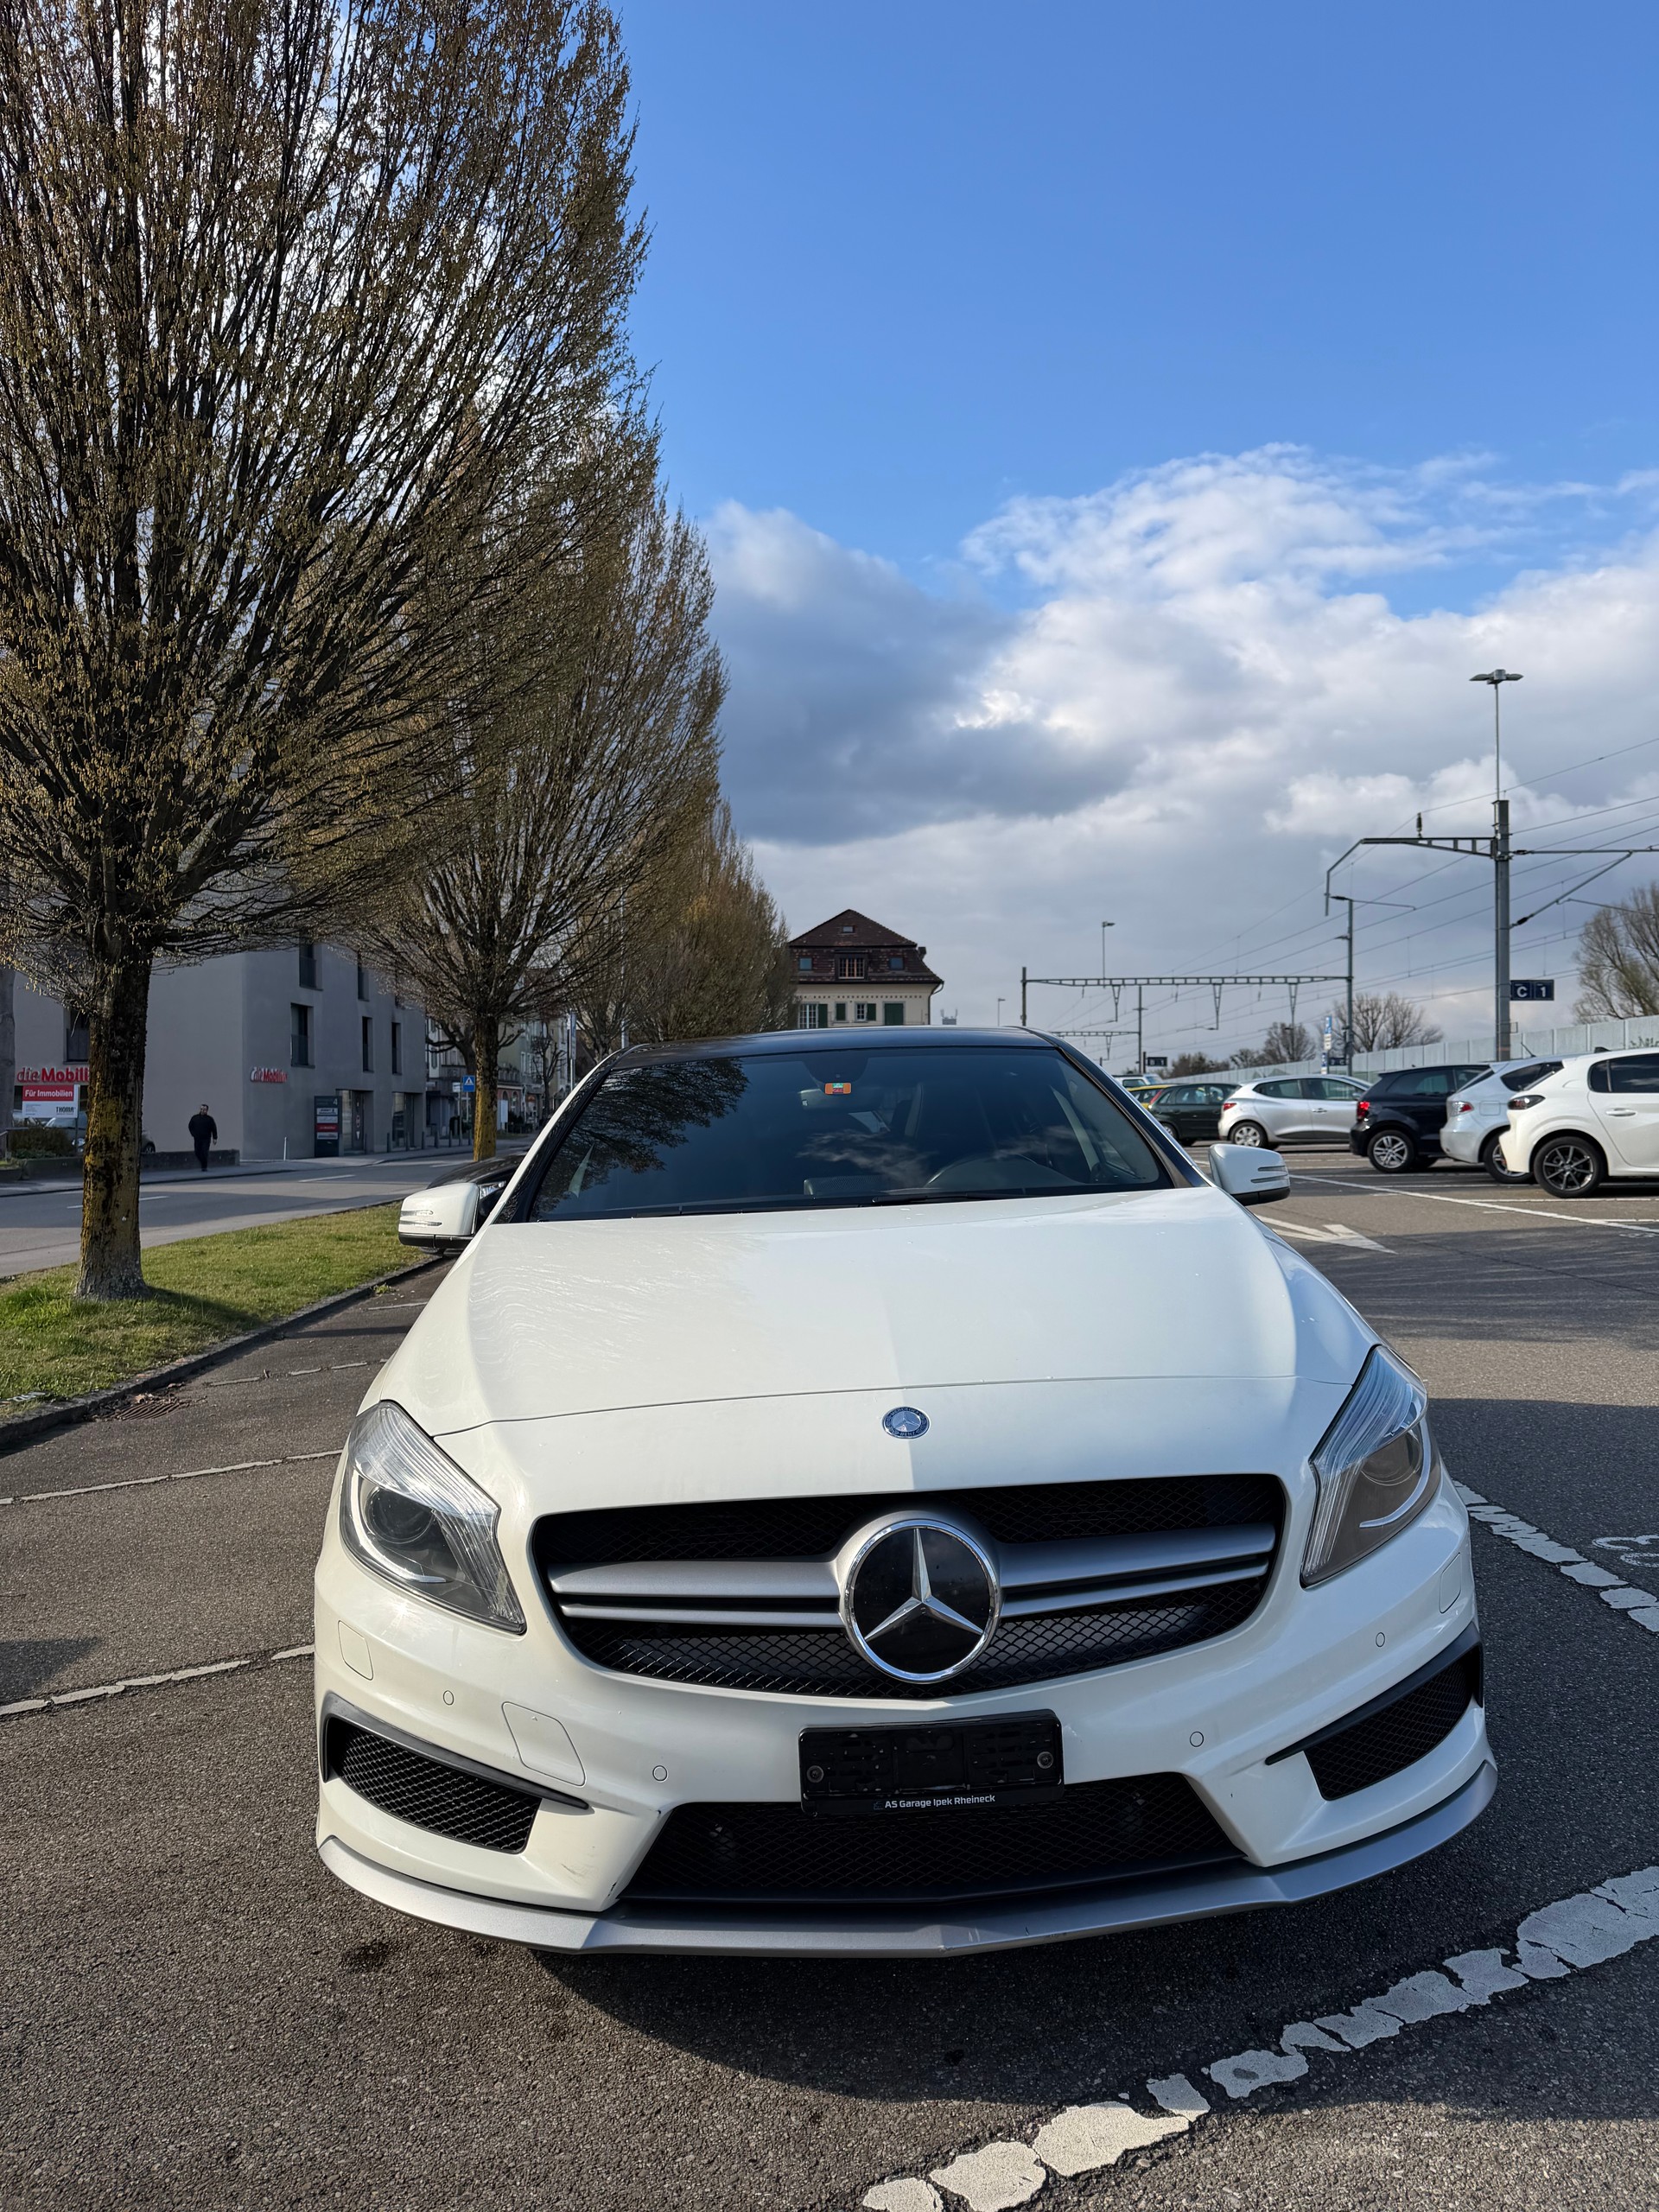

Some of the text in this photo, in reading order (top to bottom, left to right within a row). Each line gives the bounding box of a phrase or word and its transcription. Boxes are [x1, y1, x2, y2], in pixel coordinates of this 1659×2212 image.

[1516, 986, 1528, 998] C
[17, 1067, 89, 1083] die Mobili
[885, 1795, 995, 1808] AS Garage Ipek Rheineck
